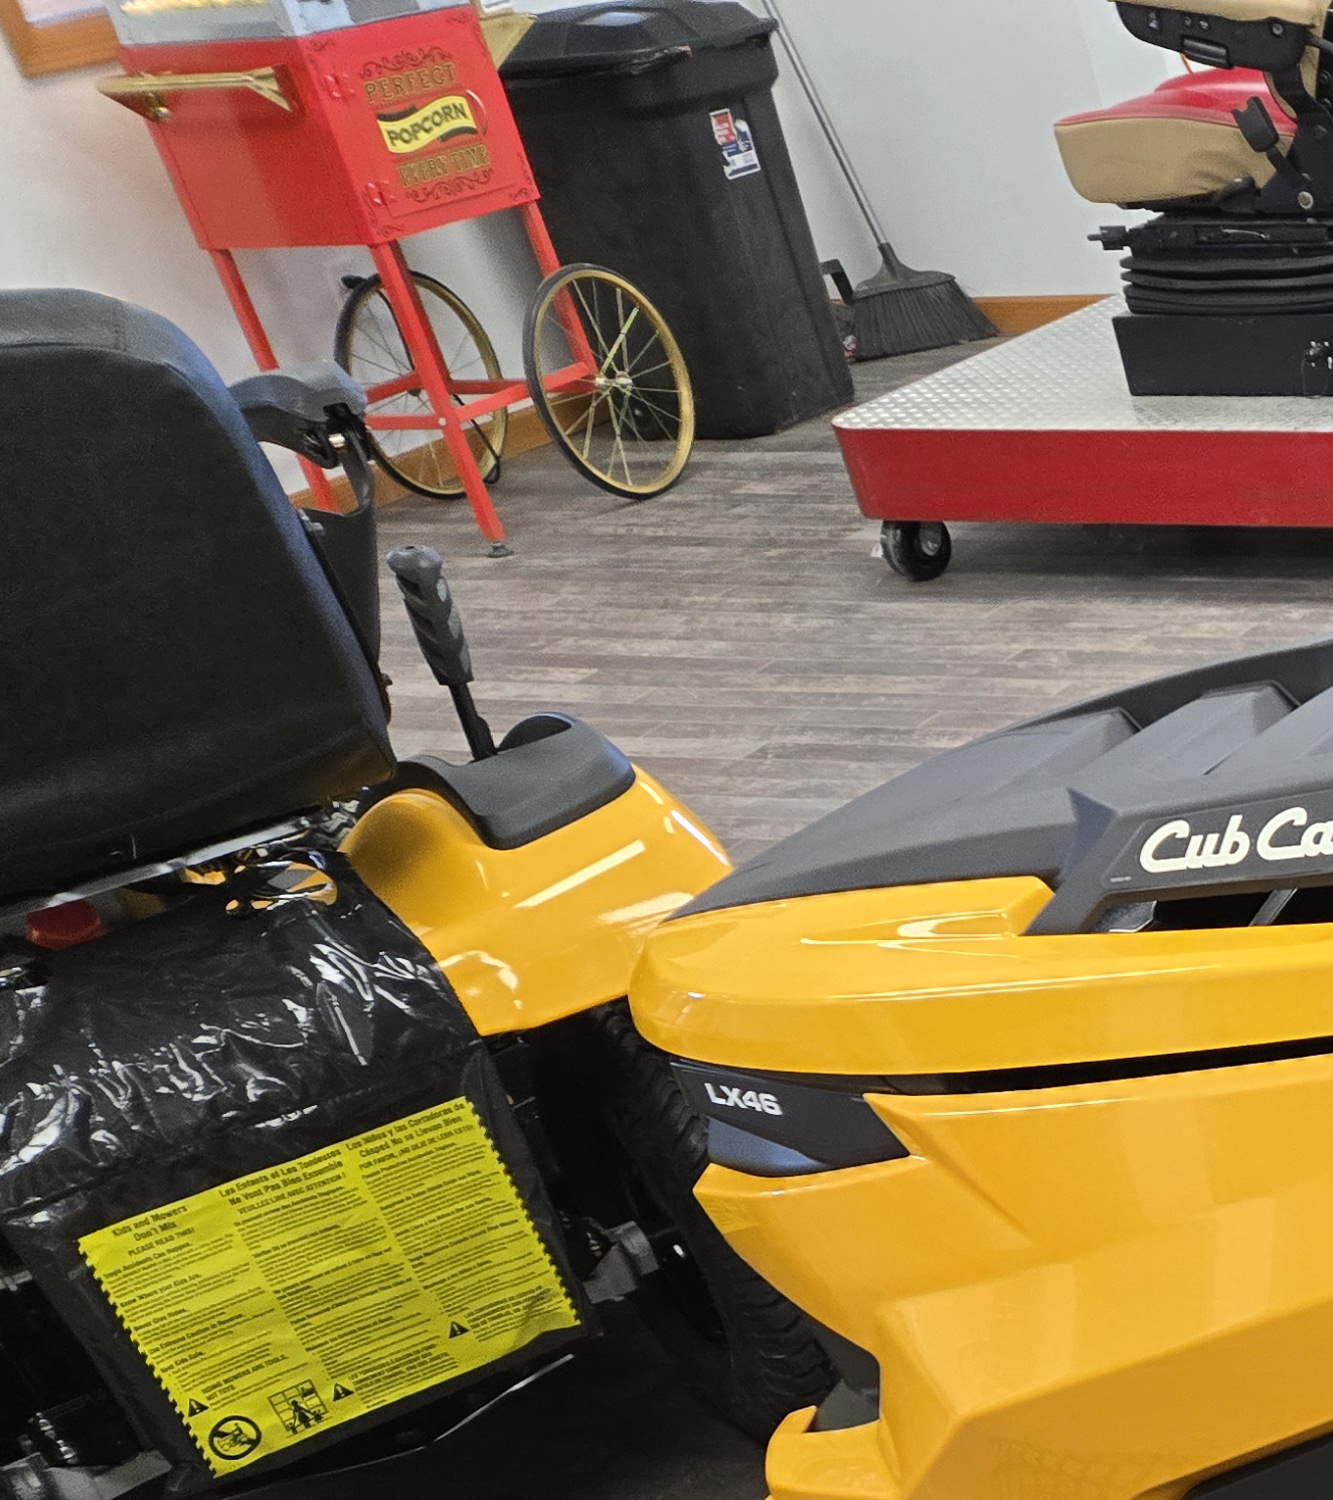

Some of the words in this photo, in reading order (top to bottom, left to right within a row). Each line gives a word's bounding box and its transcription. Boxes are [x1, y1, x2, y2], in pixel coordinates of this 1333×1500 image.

[364, 62, 457, 104] PERFECT
[386, 102, 468, 147] POPCORN
[1140, 815, 1250, 873] Cub
[704, 1083, 783, 1115] LX46
[131, 1216, 151, 1230] and
[149, 1202, 188, 1223] Mowers
